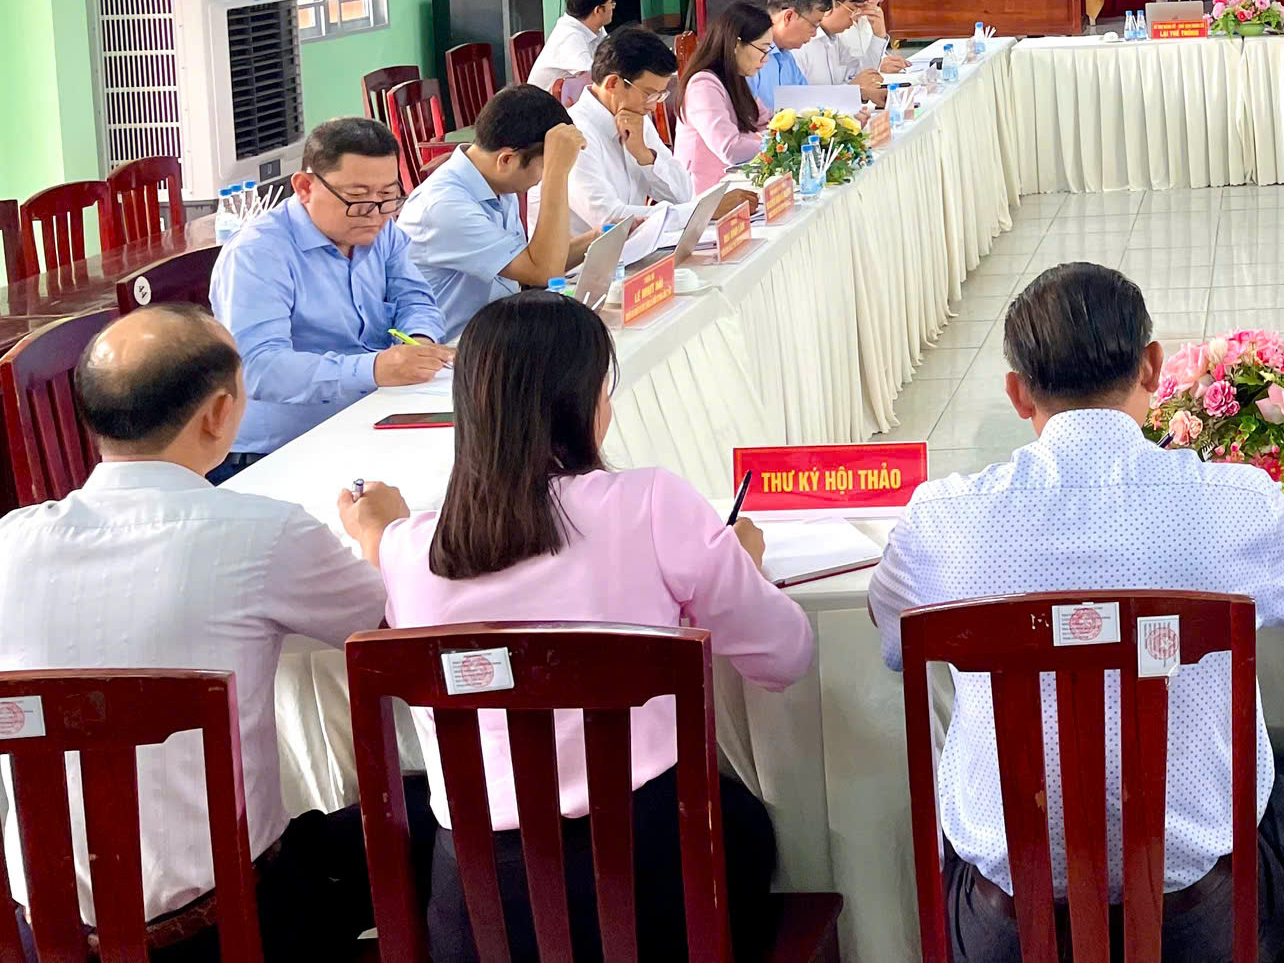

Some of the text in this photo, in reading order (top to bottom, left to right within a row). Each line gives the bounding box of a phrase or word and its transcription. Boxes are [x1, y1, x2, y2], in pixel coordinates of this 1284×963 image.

[761, 462, 902, 495] THƯ KÝ HỘI THẢO
